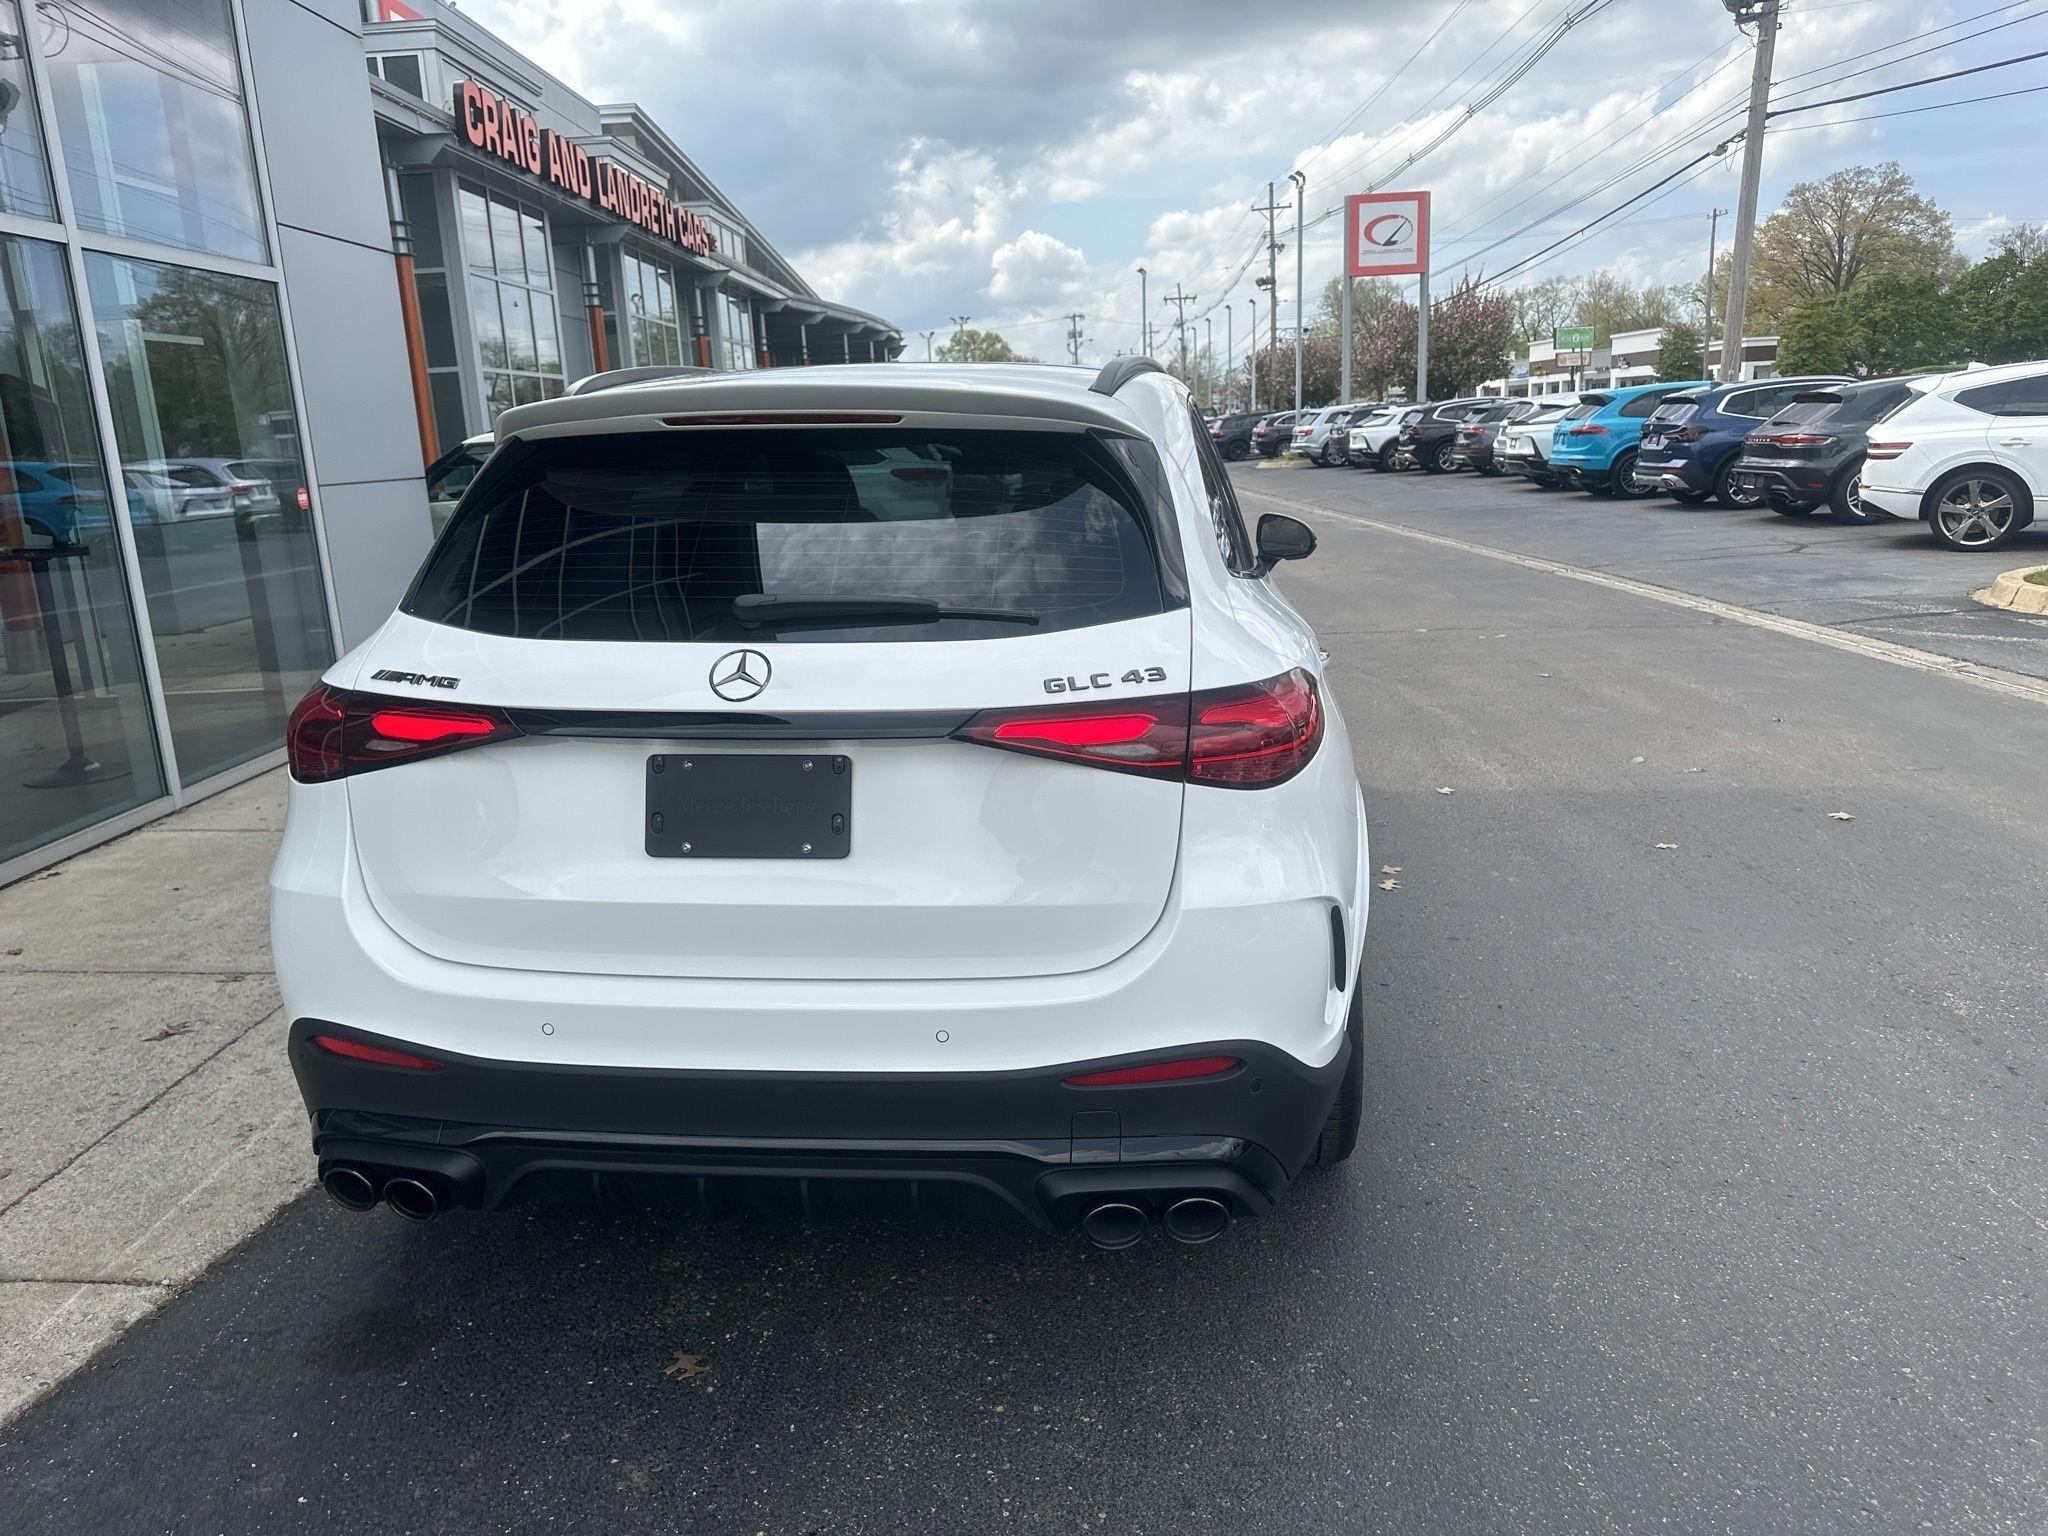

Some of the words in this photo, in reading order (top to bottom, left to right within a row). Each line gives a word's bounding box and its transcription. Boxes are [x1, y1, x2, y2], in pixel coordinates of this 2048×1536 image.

[462, 79, 541, 176] CRAIG
[547, 128, 592, 200] AND
[595, 157, 677, 242] LANDRETH
[678, 206, 710, 258] CARS
[391, 671, 460, 690] AMG
[1043, 672, 1112, 694] GLC
[1121, 666, 1167, 684] 43
